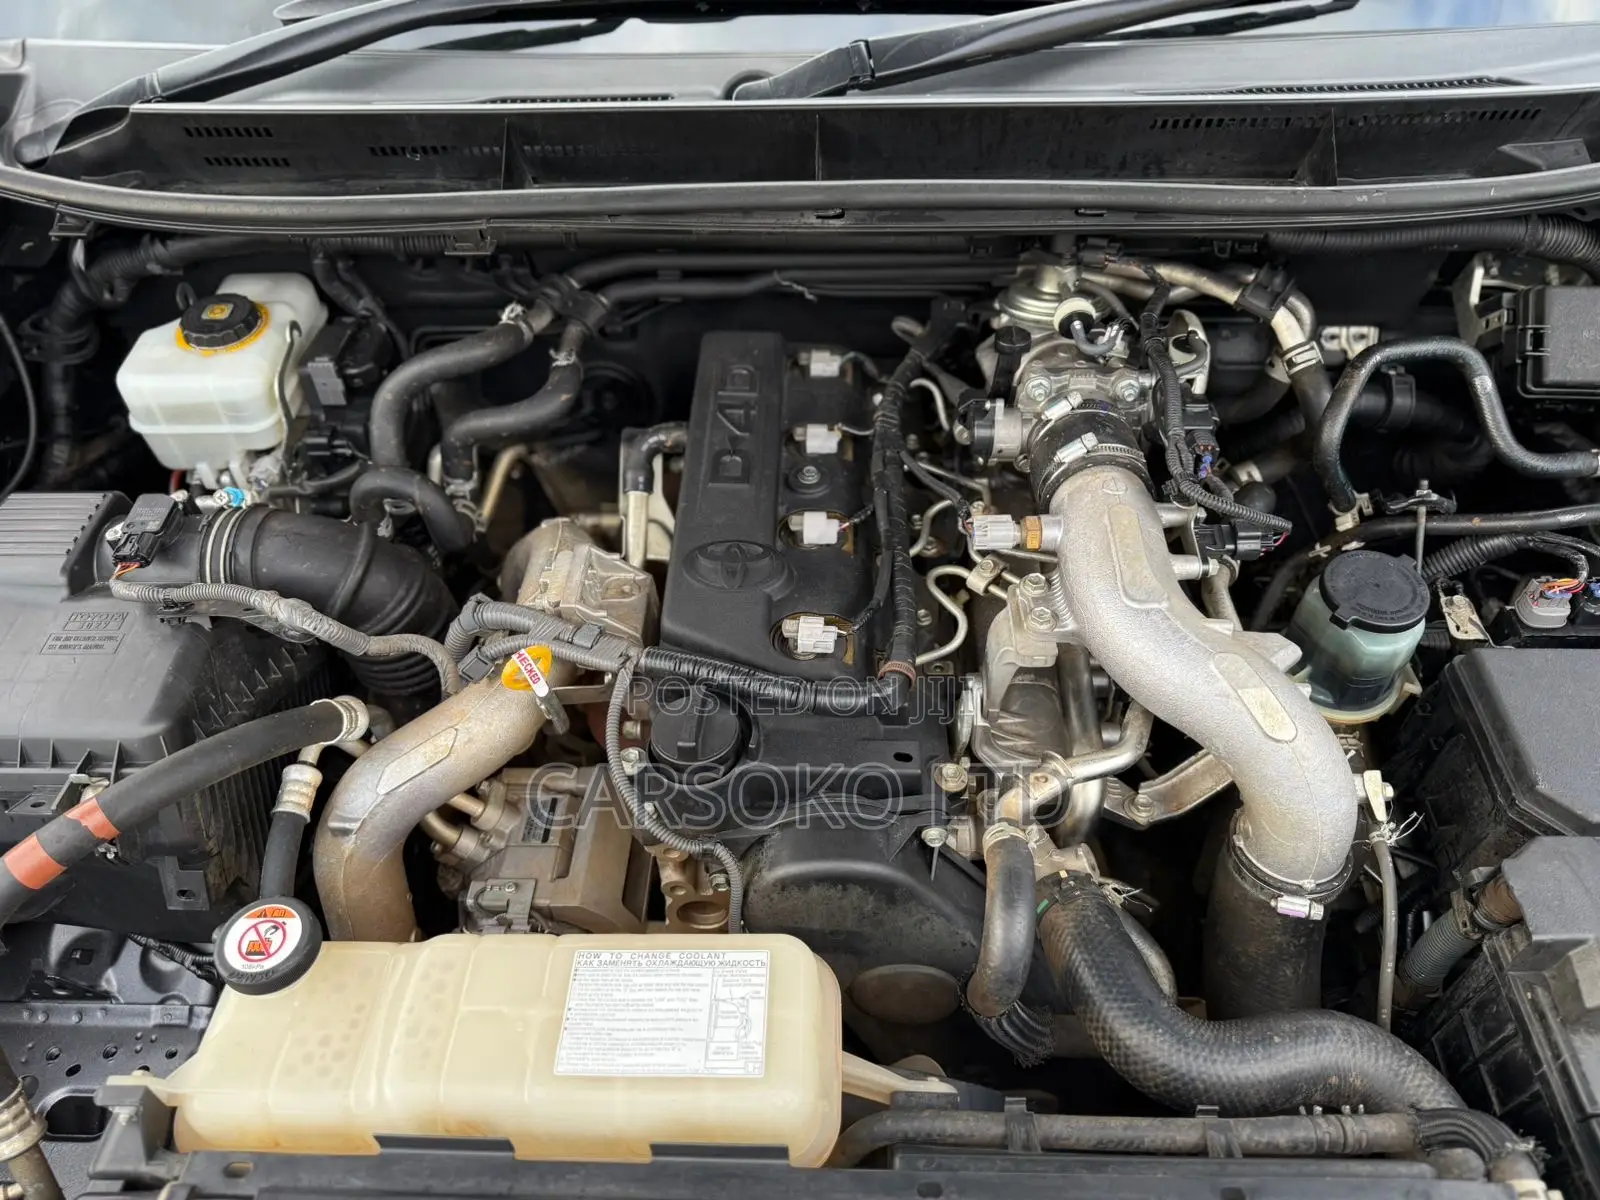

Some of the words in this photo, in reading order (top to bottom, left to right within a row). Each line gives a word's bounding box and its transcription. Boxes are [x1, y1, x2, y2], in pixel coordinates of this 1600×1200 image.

[515, 651, 541, 685] HECKED
[578, 952, 602, 960] HOW
[610, 952, 623, 960] TO
[630, 952, 671, 960] CHANGE
[679, 952, 727, 960] COOLANT
